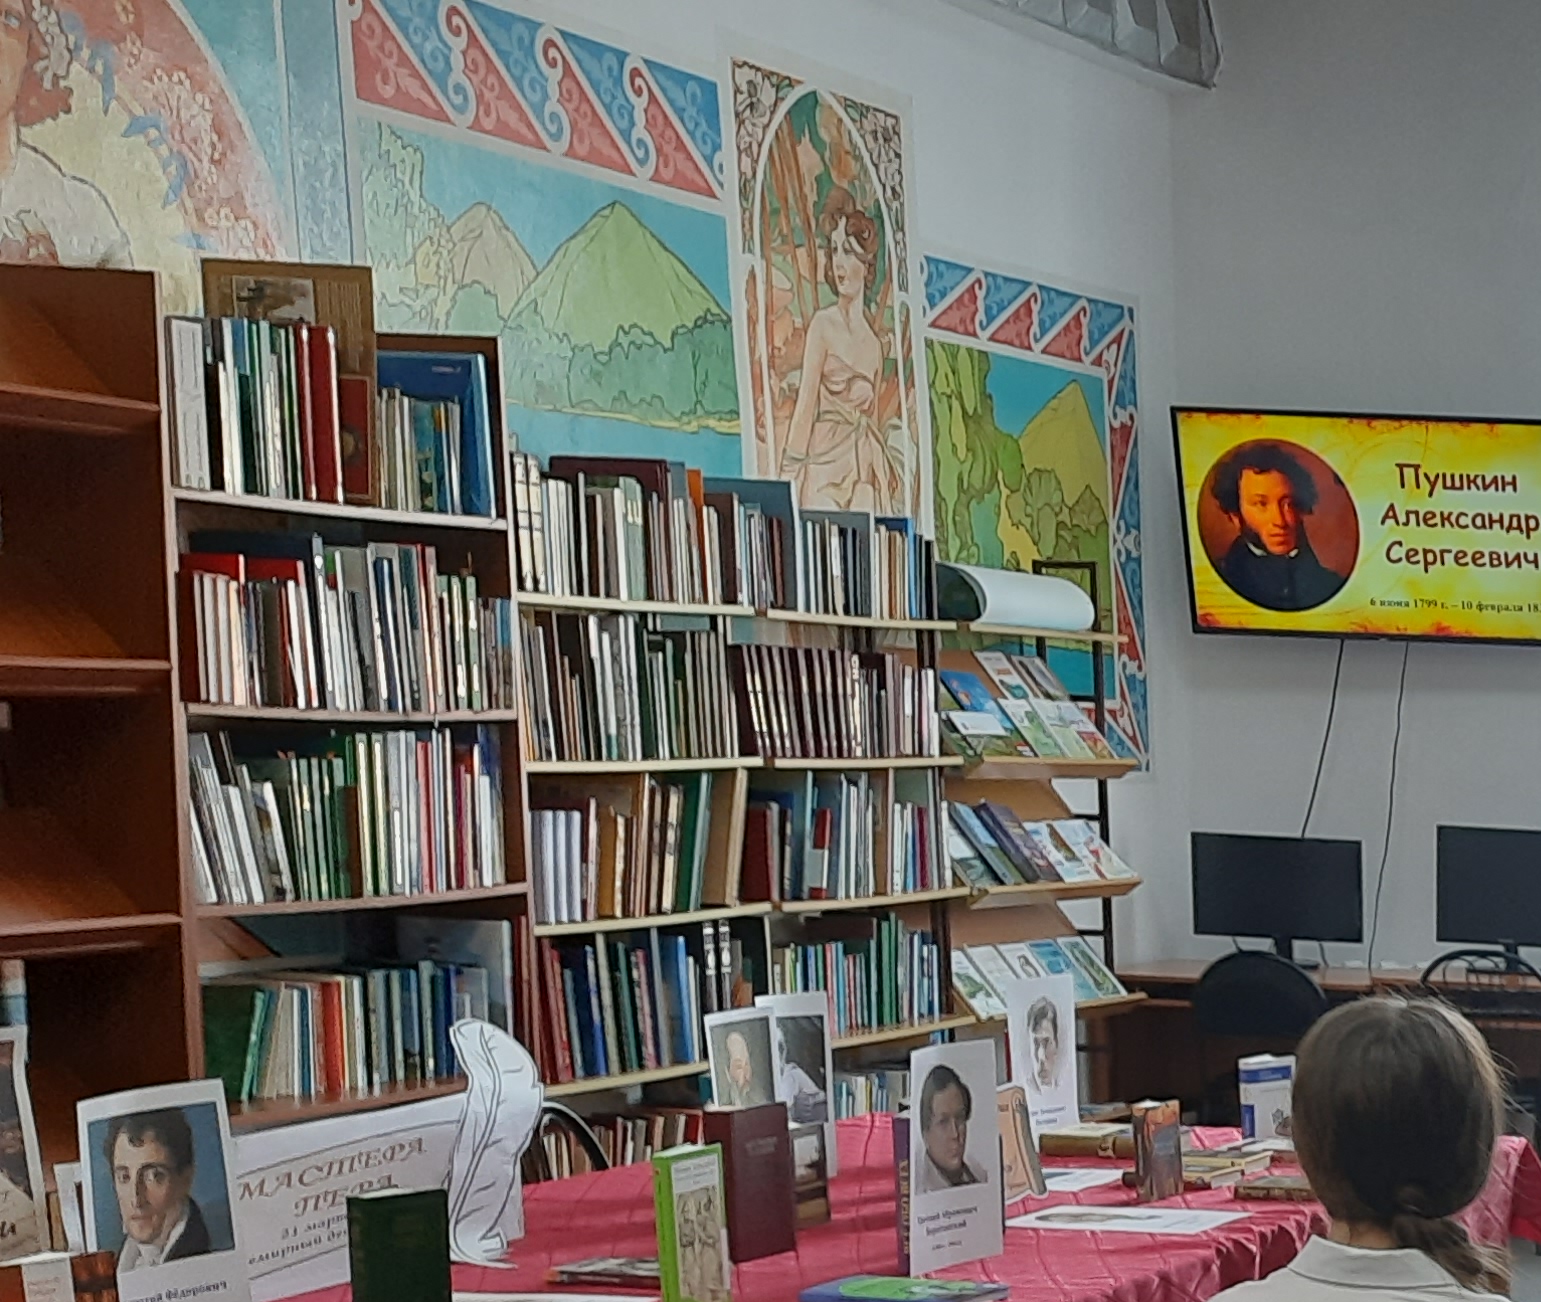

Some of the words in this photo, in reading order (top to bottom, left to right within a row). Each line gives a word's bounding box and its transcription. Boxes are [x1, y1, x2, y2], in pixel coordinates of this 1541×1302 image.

[1395, 463, 1517, 498] Пушкин
[1380, 502, 1540, 540] Александр
[1385, 540, 1539, 573] Сергеевич
[1370, 597, 1376, 606] 6
[1413, 598, 1438, 609] 1799
[1461, 600, 1473, 611] 10
[1476, 601, 1524, 614] февраля
